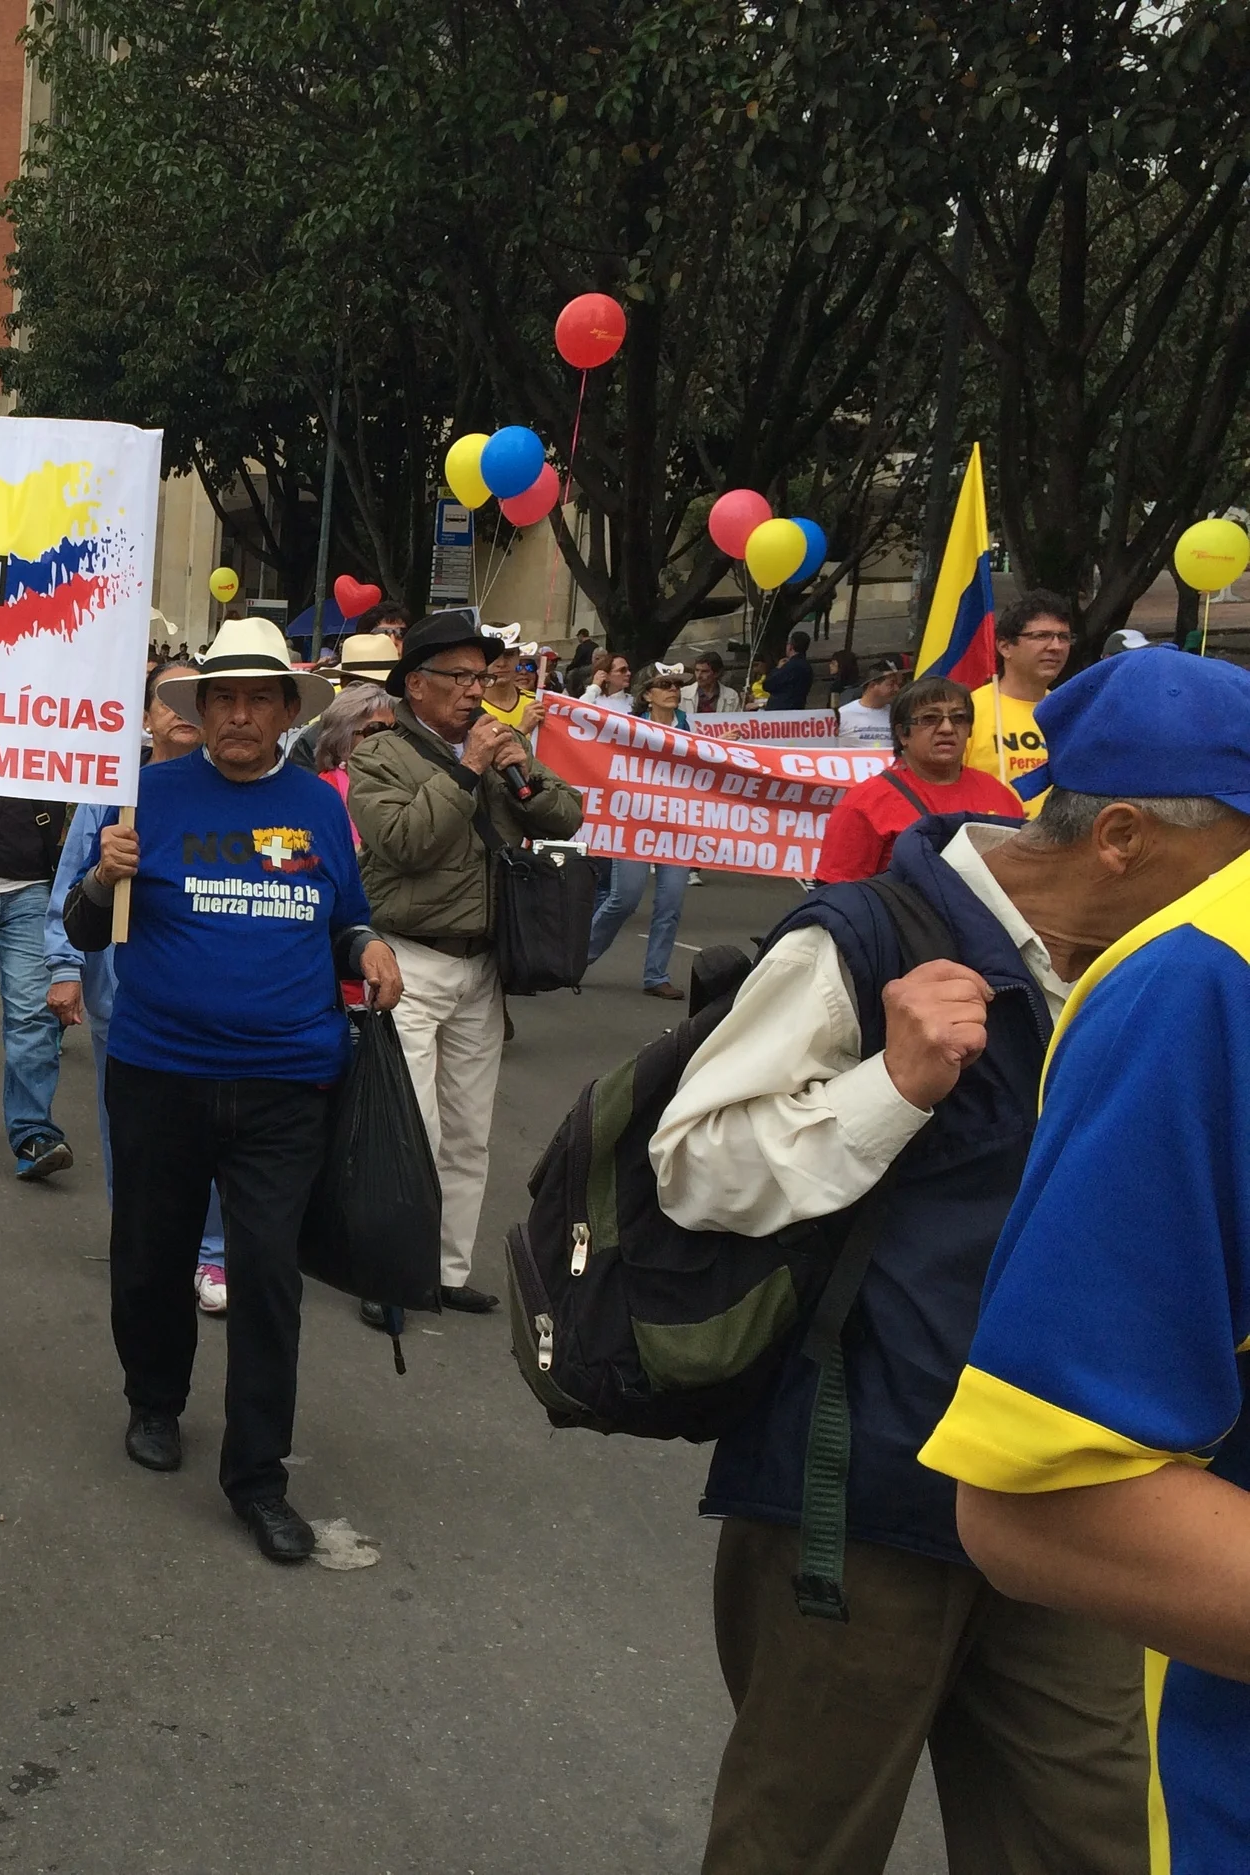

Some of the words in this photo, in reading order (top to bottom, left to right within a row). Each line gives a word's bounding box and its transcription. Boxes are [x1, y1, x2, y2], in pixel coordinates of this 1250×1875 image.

[608, 754, 716, 792] ALIADO
[720, 772, 763, 799] DE
[765, 780, 804, 804] LA
[780, 753, 895, 783] COR
[609, 790, 770, 835] QUEREMOS
[634, 828, 777, 870] CAUSADO
[782, 845, 804, 873] A
[184, 876, 291, 900] Humillación
[294, 886, 304, 901] a
[306, 885, 320, 904] la
[192, 893, 248, 915] fuerza
